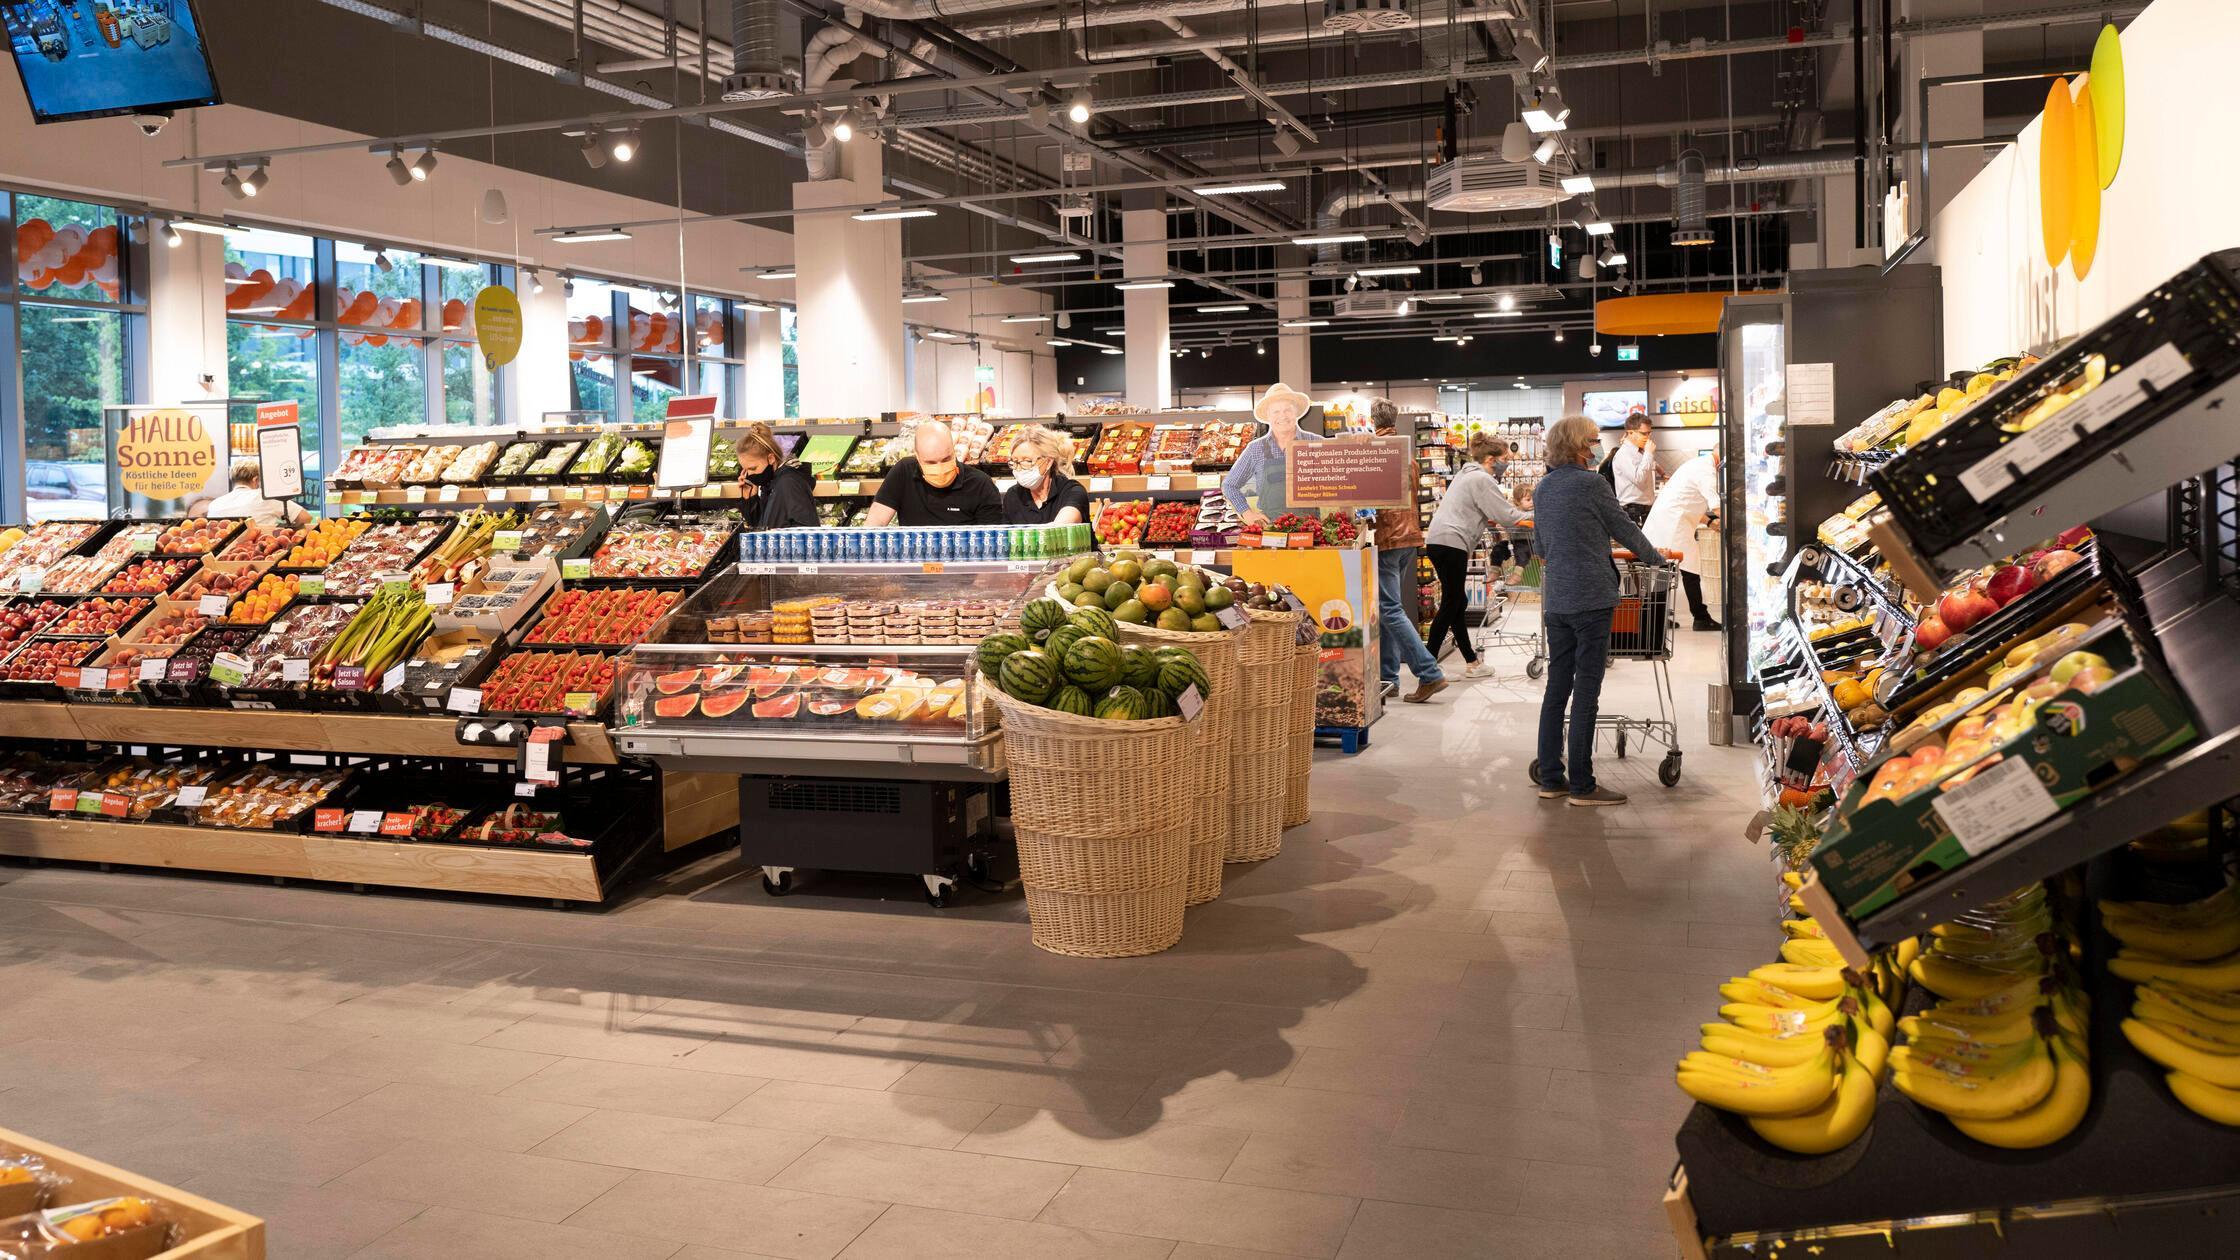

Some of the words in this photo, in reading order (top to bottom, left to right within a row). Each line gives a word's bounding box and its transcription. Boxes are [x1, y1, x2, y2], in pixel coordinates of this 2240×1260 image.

[260, 408, 289, 420] Angebot
[130, 415, 203, 444] HALLO
[117, 444, 216, 468] Sonne!
[1308, 449, 1343, 459] regionalen
[1343, 448, 1378, 456] Produkten
[1378, 447, 1400, 455] haben
[1297, 459, 1320, 467] tegut...
[1358, 456, 1388, 465] gleichen
[125, 470, 168, 479] Köstliche
[171, 470, 197, 479] Ideen
[1297, 466, 1331, 475] Anspruch:
[1331, 465, 1345, 473] hier
[1346, 465, 1384, 474] gewachsen,
[1311, 474, 1348, 482] verarbeitet.
[135, 480, 148, 491] für
[151, 480, 177, 491] heiße
[180, 481, 204, 493] Tage.
[1319, 650, 1341, 659] egut...
[173, 662, 185, 670] Jetzt
[185, 661, 193, 669] ist
[171, 669, 188, 677] Saison
[337, 669, 351, 677] Jetzt
[337, 678, 356, 686] Saison
[53, 793, 72, 801] Angebot
[104, 797, 124, 806] Angebot
[317, 814, 342, 827] kracher!
[385, 819, 412, 831] kracher!
